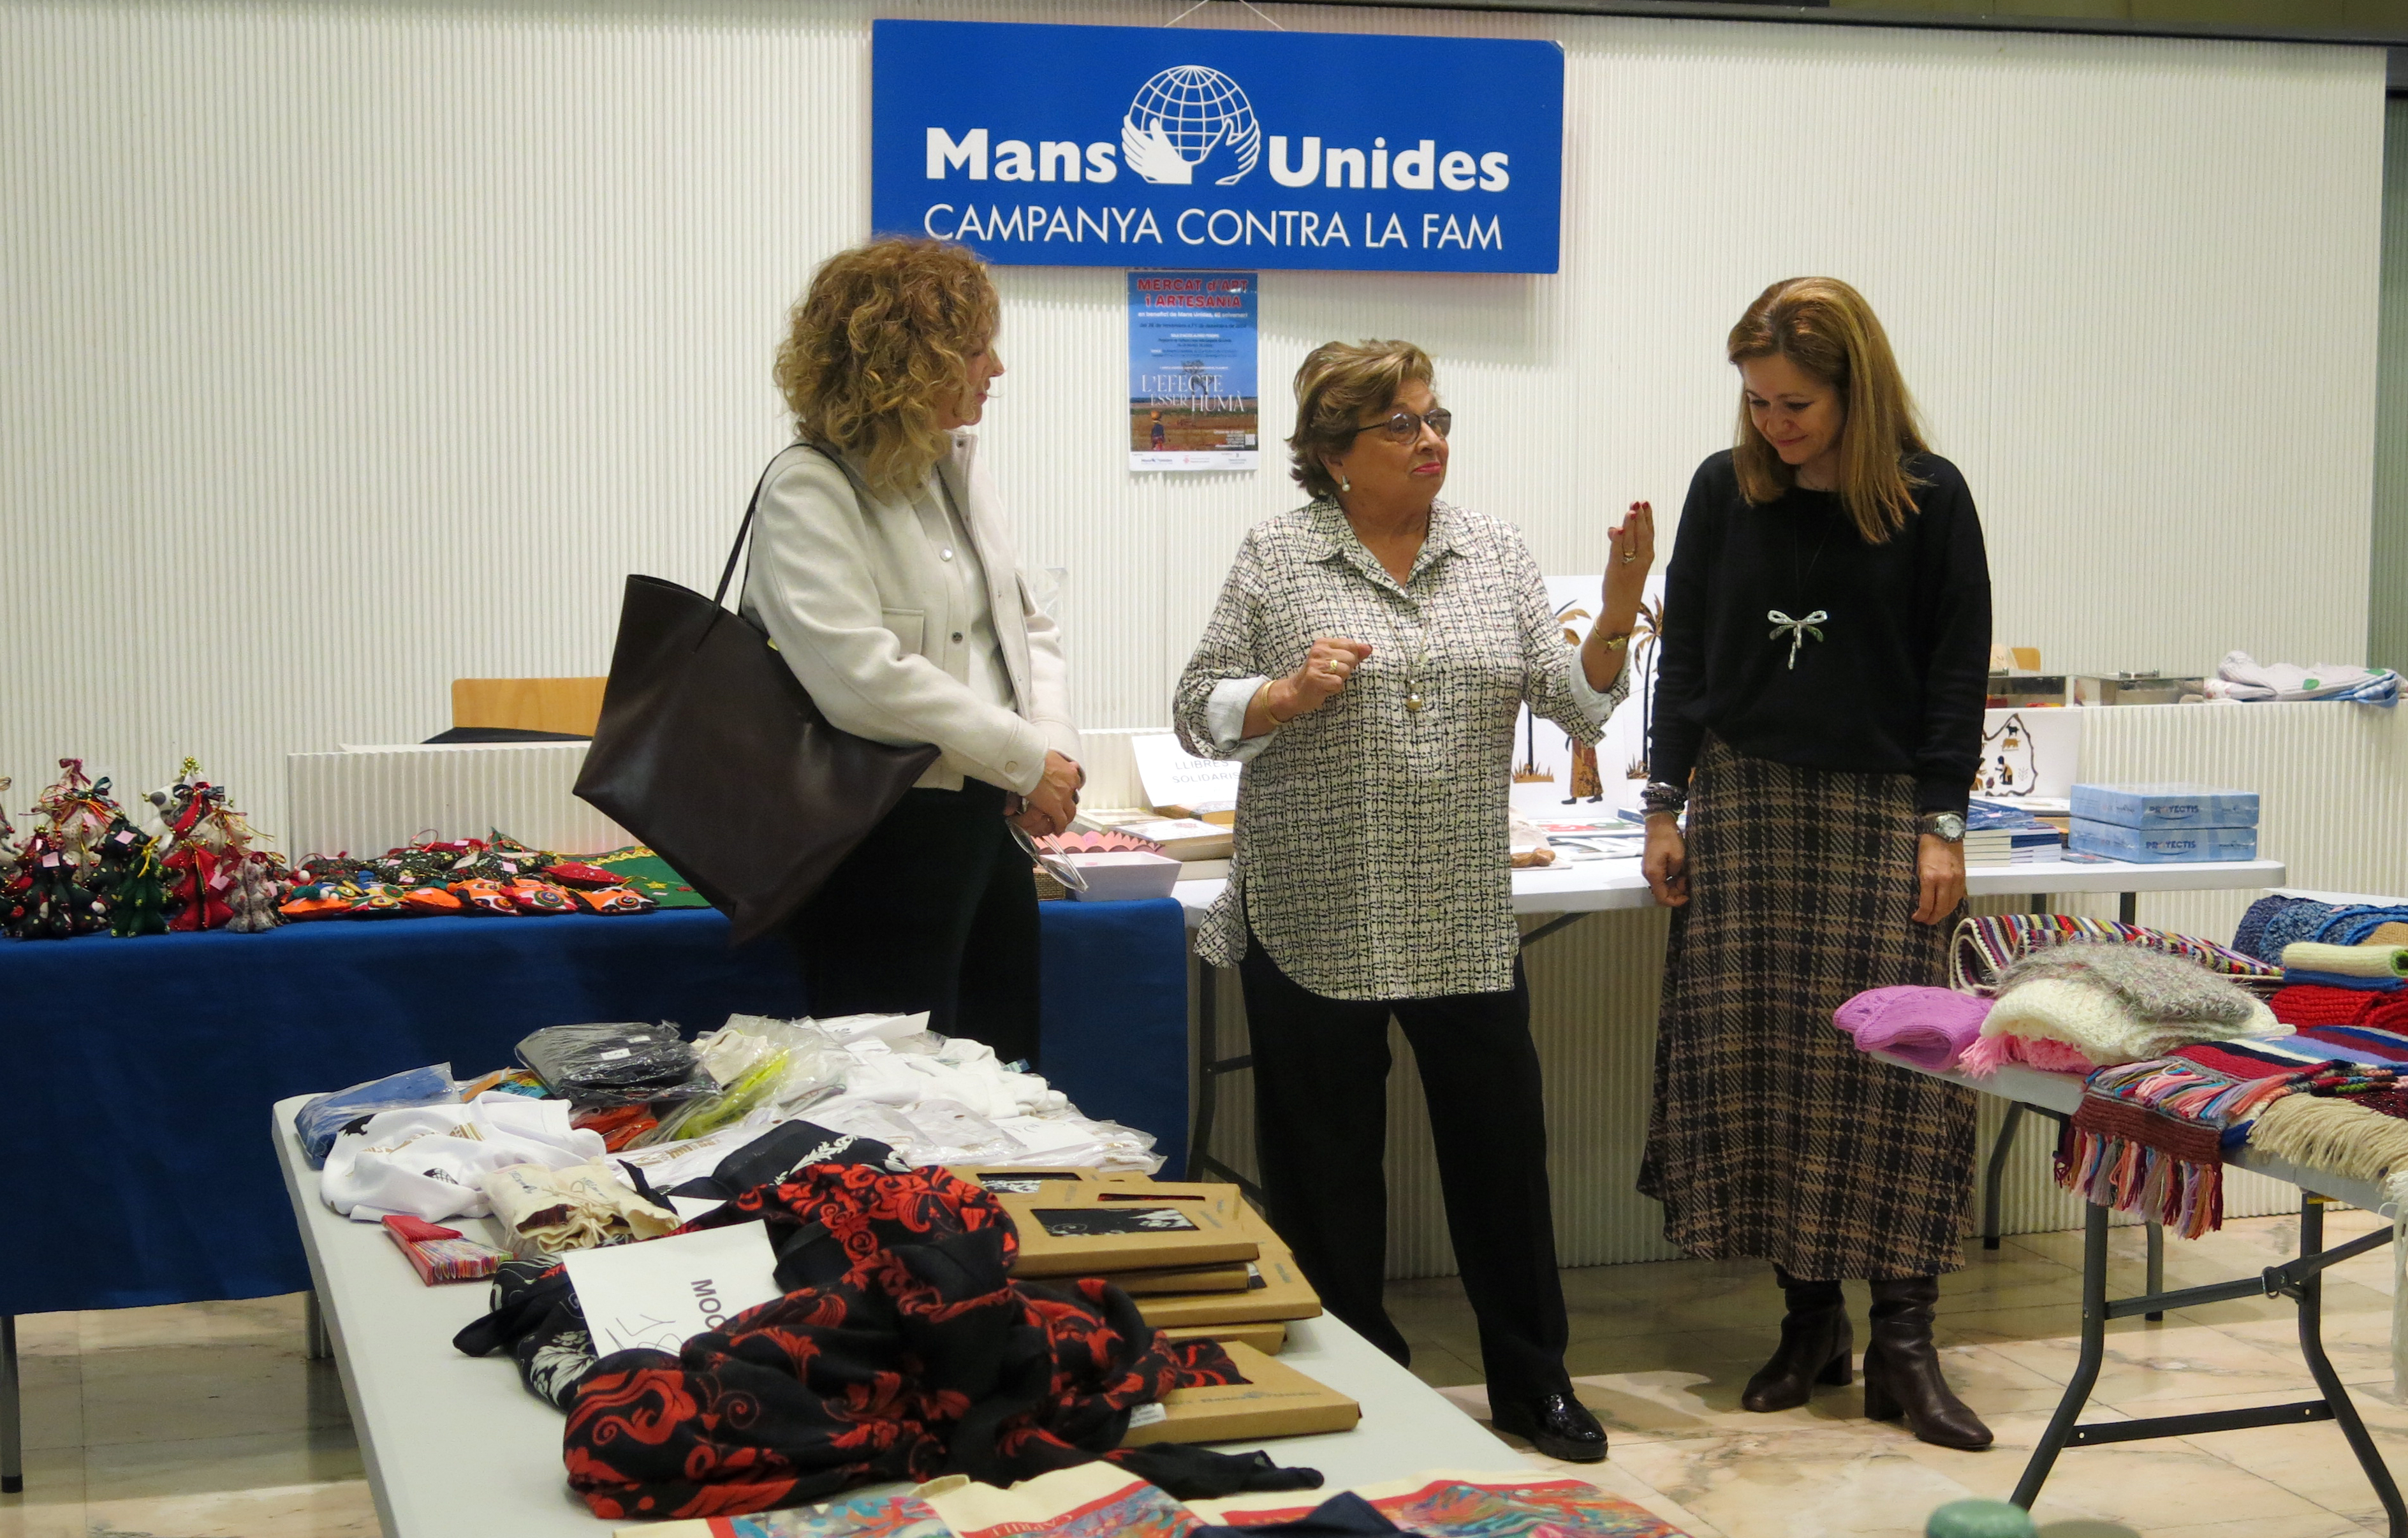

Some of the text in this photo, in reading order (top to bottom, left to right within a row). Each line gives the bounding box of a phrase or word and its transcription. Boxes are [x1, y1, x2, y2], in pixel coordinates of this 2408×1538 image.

[927, 128, 1509, 191] Mans Unides
[925, 204, 1502, 249] CAMPANYA CONTRA LA FAM
[1138, 279, 1248, 292] MERCAT d'ART
[1155, 295, 1242, 307] ARTESANIA
[1142, 374, 1224, 392] L'EFECTE
[1192, 390, 1244, 412] HUMÀ
[1175, 759, 1229, 770] LLIBRES
[1172, 772, 1240, 783] SOLIDARIS
